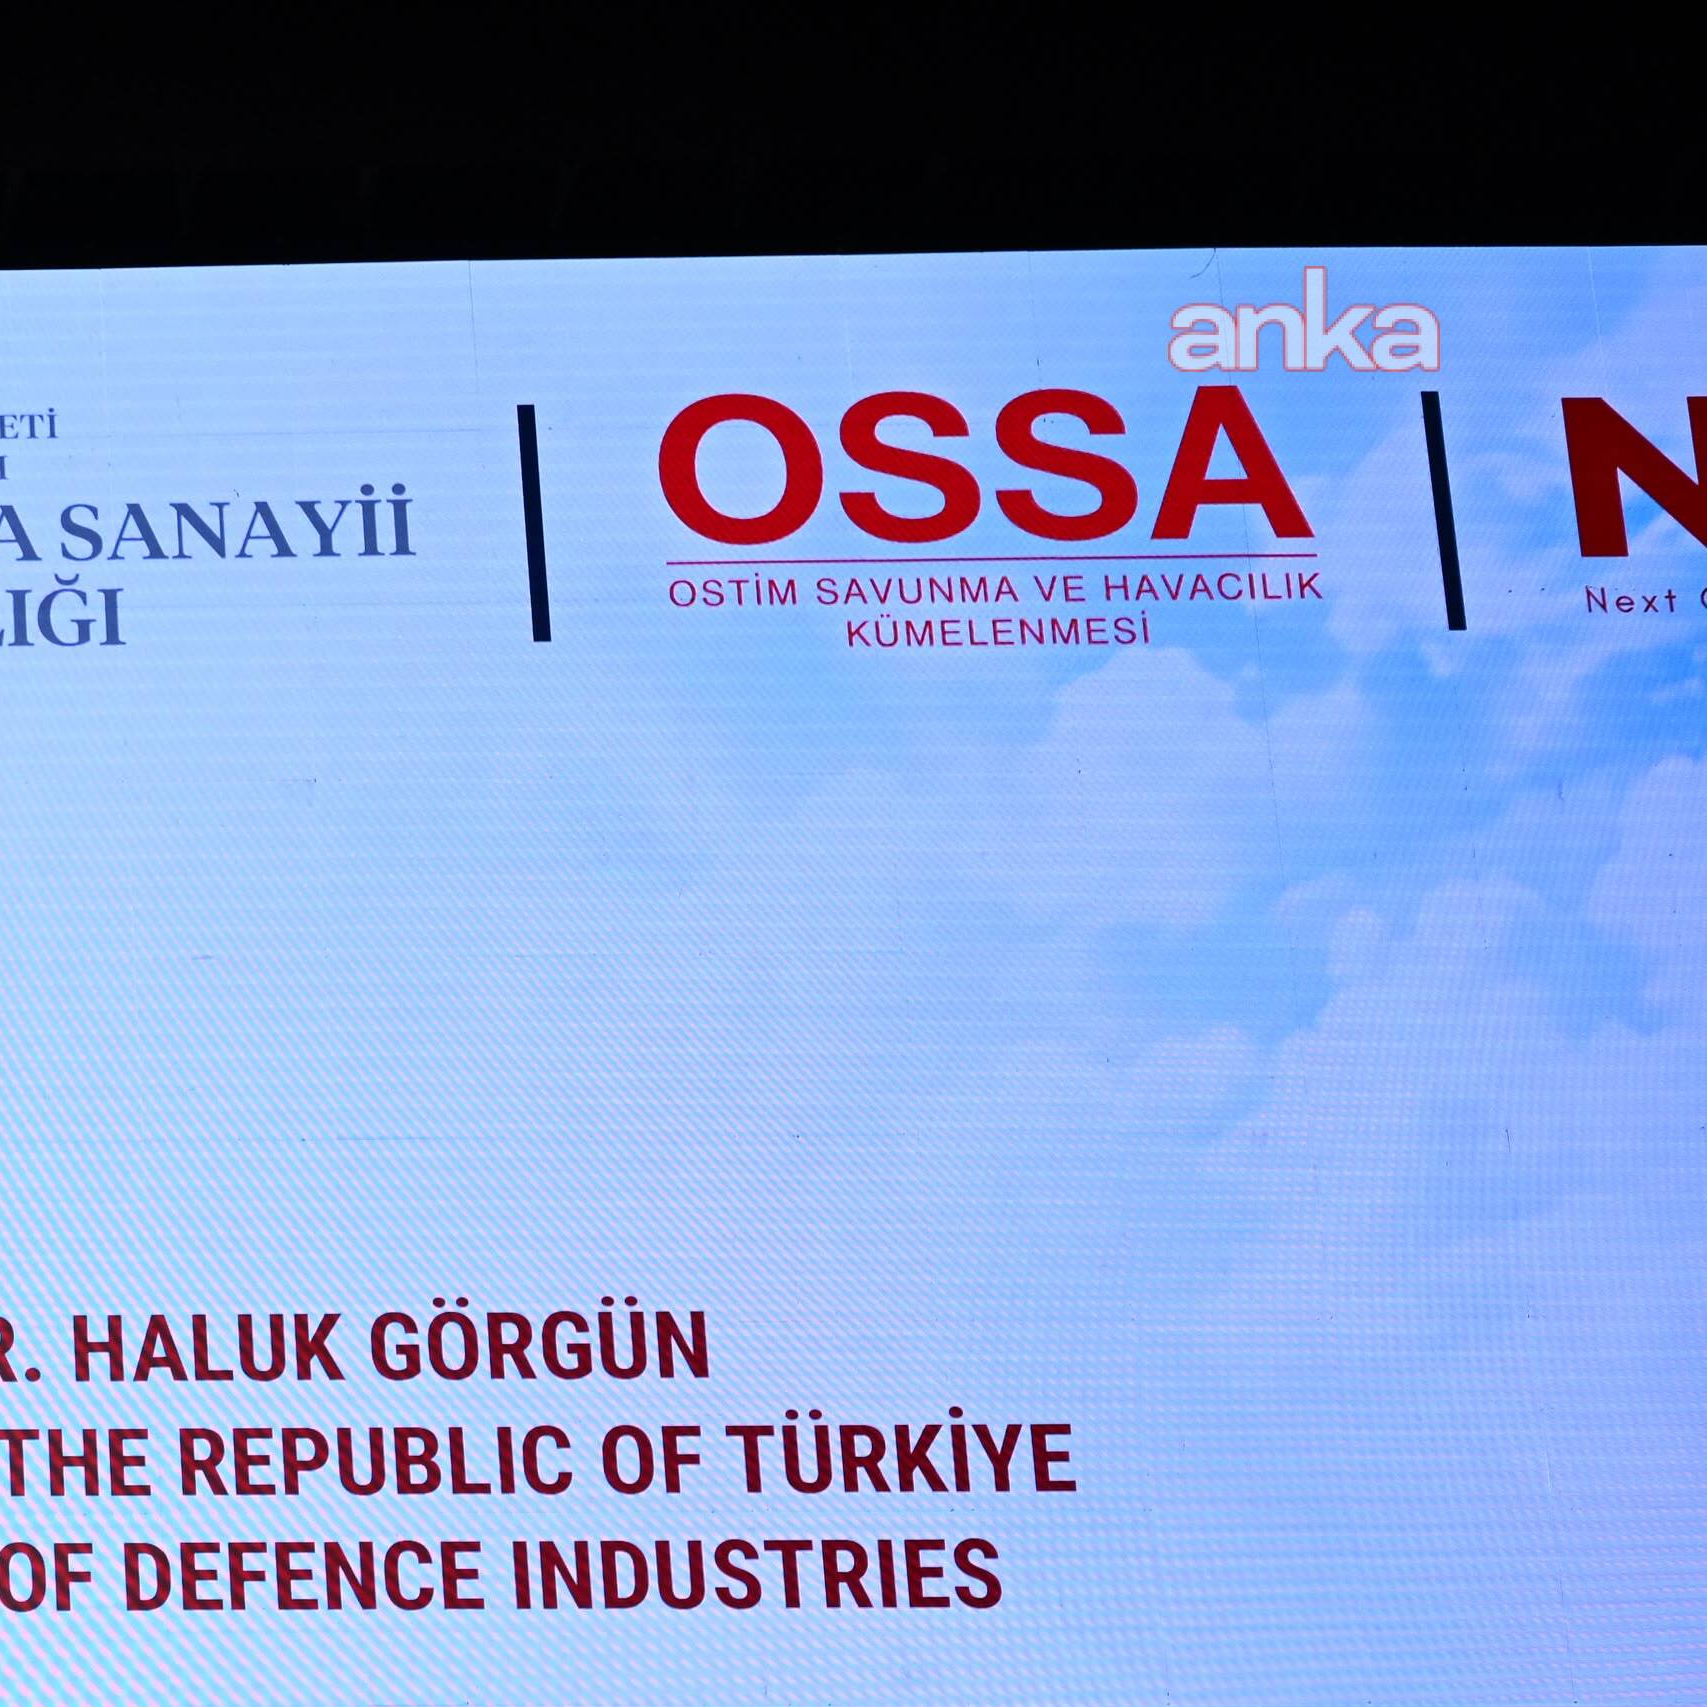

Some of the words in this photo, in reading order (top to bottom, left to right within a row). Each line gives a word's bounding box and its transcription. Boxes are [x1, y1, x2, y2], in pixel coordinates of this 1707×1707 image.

[659, 385, 1314, 545] OSSA
[60, 484, 416, 562] SANAYİİ
[669, 579, 798, 607] OSTİM
[817, 576, 1018, 605] SAVUNMA
[1034, 575, 1085, 602] VE
[1104, 572, 1323, 601] HAVACILIK
[1586, 586, 1676, 613] Next
[846, 610, 1150, 648] KÜMELENMESİ
[74, 1314, 345, 1381] HALUK
[371, 1296, 710, 1381] GÖRGÜN
[180, 1425, 573, 1495] REPUBLIC
[601, 1425, 702, 1494] OF
[725, 1406, 1077, 1493] TÜRKİYE
[124, 1540, 485, 1610] DEFENCE
[513, 1538, 1003, 1609] INDUSTRIES
